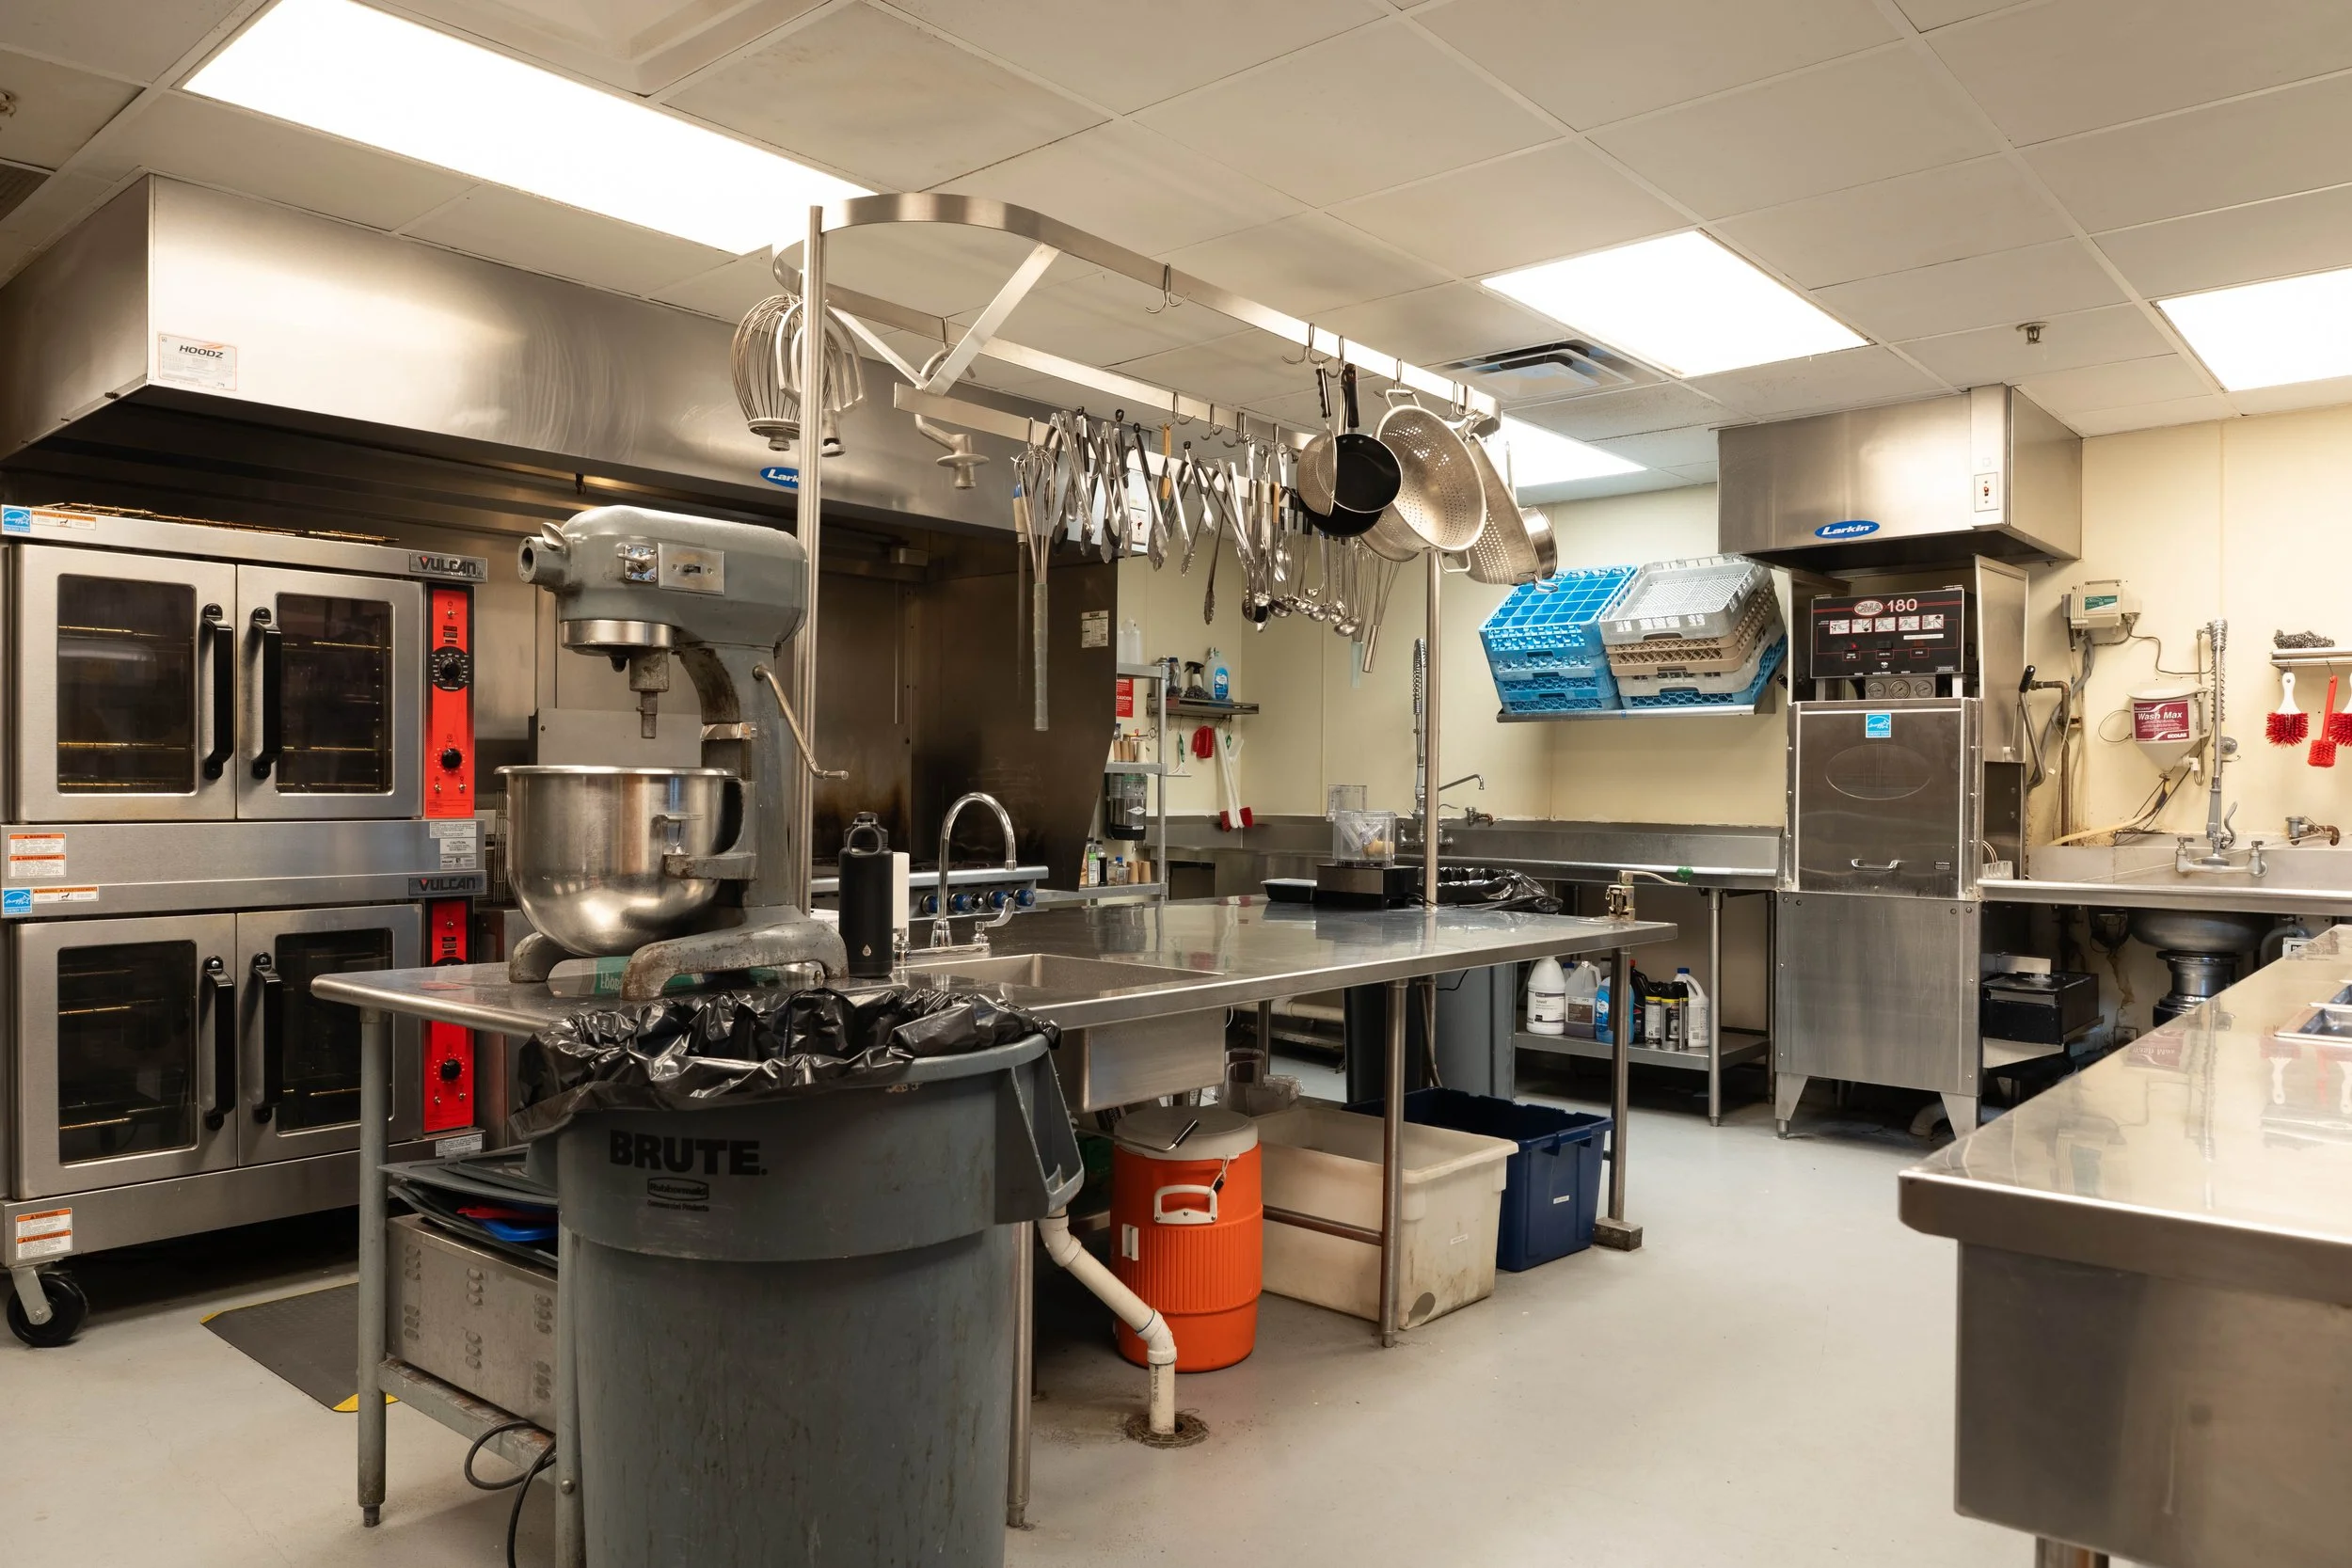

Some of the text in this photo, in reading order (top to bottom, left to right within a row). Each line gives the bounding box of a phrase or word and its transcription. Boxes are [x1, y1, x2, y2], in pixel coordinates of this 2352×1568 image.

[179, 344, 224, 358] HOODZ
[768, 468, 799, 483] Lark
[1821, 524, 1871, 535] Larkin
[419, 556, 477, 575] VULCAN
[1855, 598, 1918, 612] CMA 180
[2137, 711, 2183, 721] Wash Max
[419, 878, 476, 892] VULCAN
[650, 1181, 706, 1196] Rubbermaid
